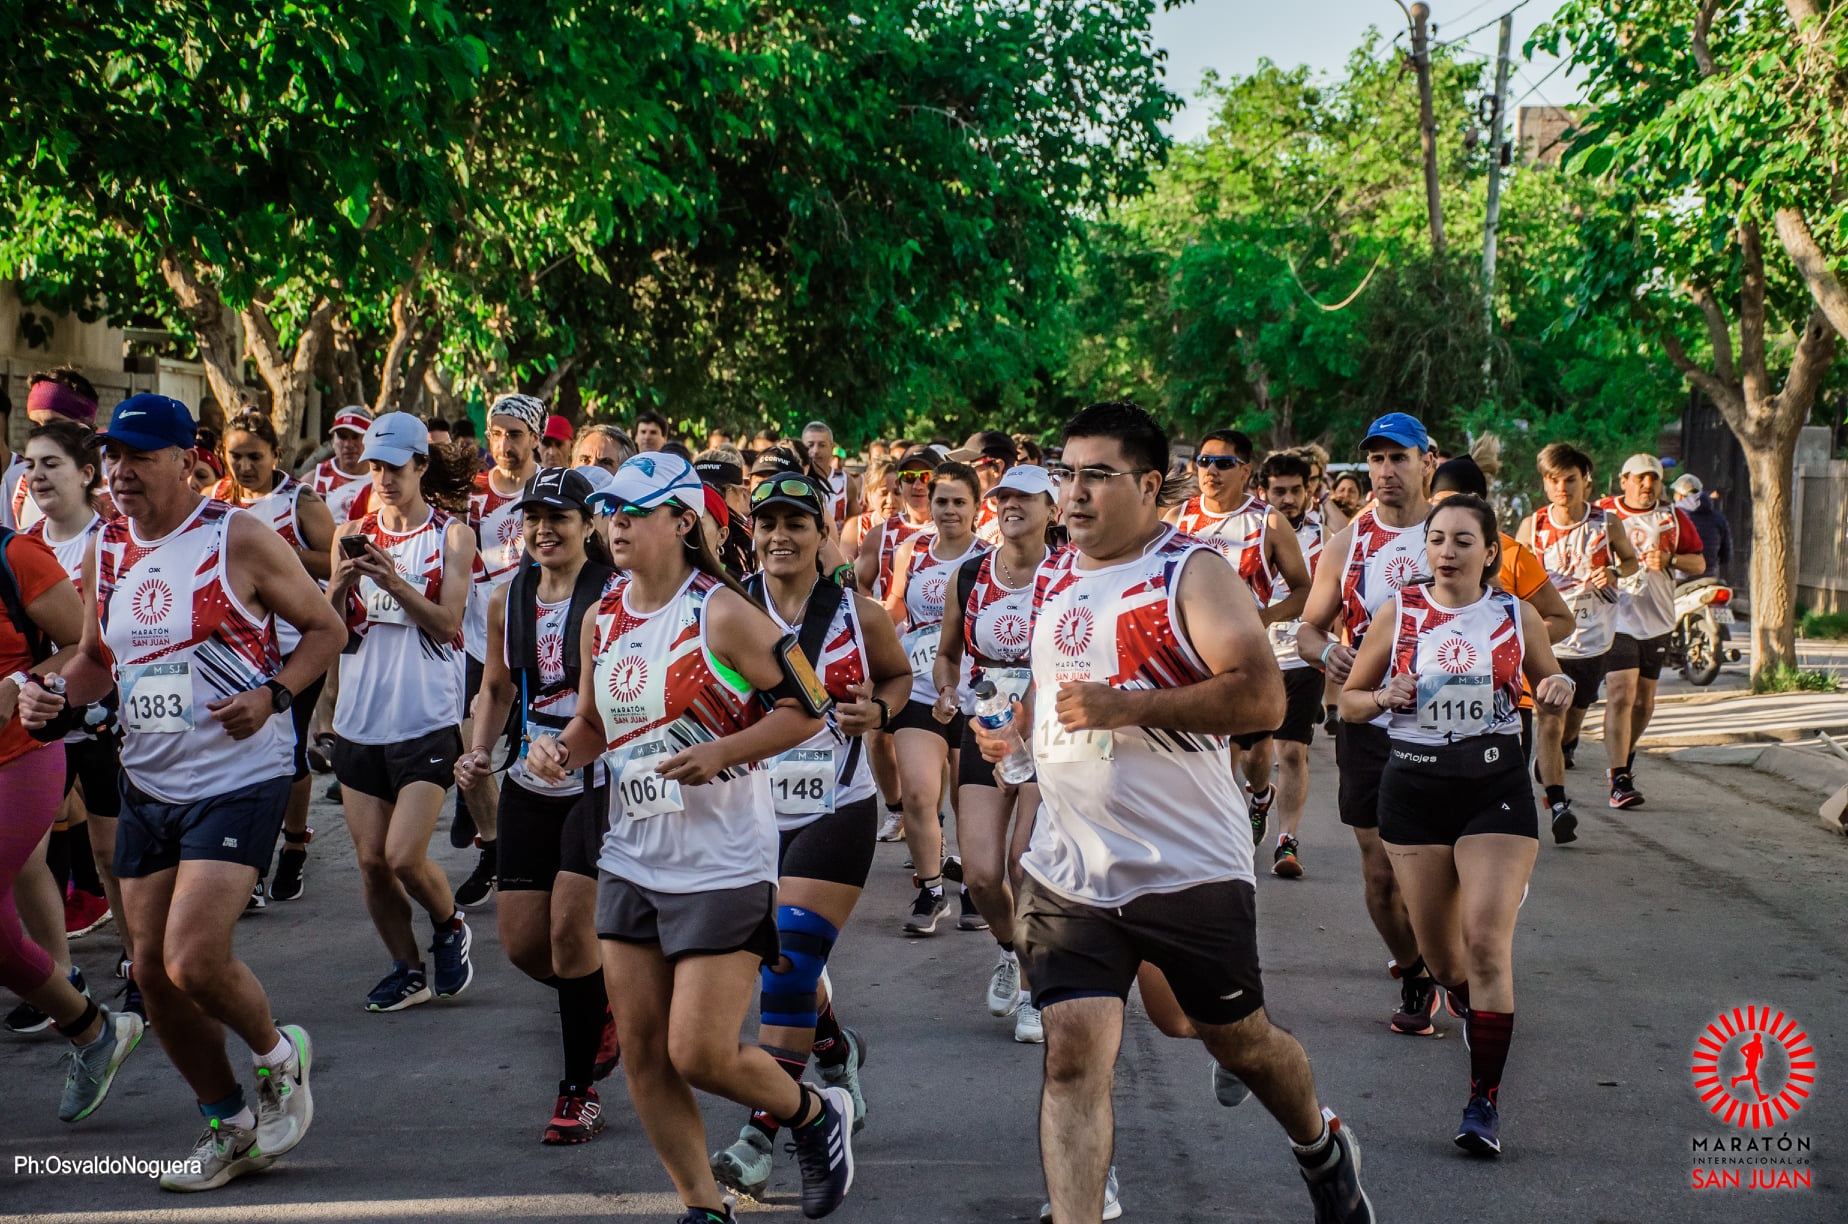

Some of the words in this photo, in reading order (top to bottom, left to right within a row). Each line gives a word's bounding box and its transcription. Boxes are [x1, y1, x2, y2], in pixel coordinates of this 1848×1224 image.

[132, 639, 148, 647] SAN
[150, 638, 170, 646] JUAN
[153, 666, 163, 674] M
[169, 664, 180, 674] SJ
[1056, 673, 1069, 681] SAN
[1070, 672, 1091, 680] JUAN
[1474, 676, 1484, 684] SJ
[130, 693, 183, 719] 1383
[1428, 700, 1484, 721] 1116
[614, 715, 629, 725] SAN
[630, 712, 648, 724] JUAN
[649, 743, 660, 753] SJ
[798, 752, 807, 760] M
[813, 751, 824, 760] SJ
[620, 775, 667, 807] 1067
